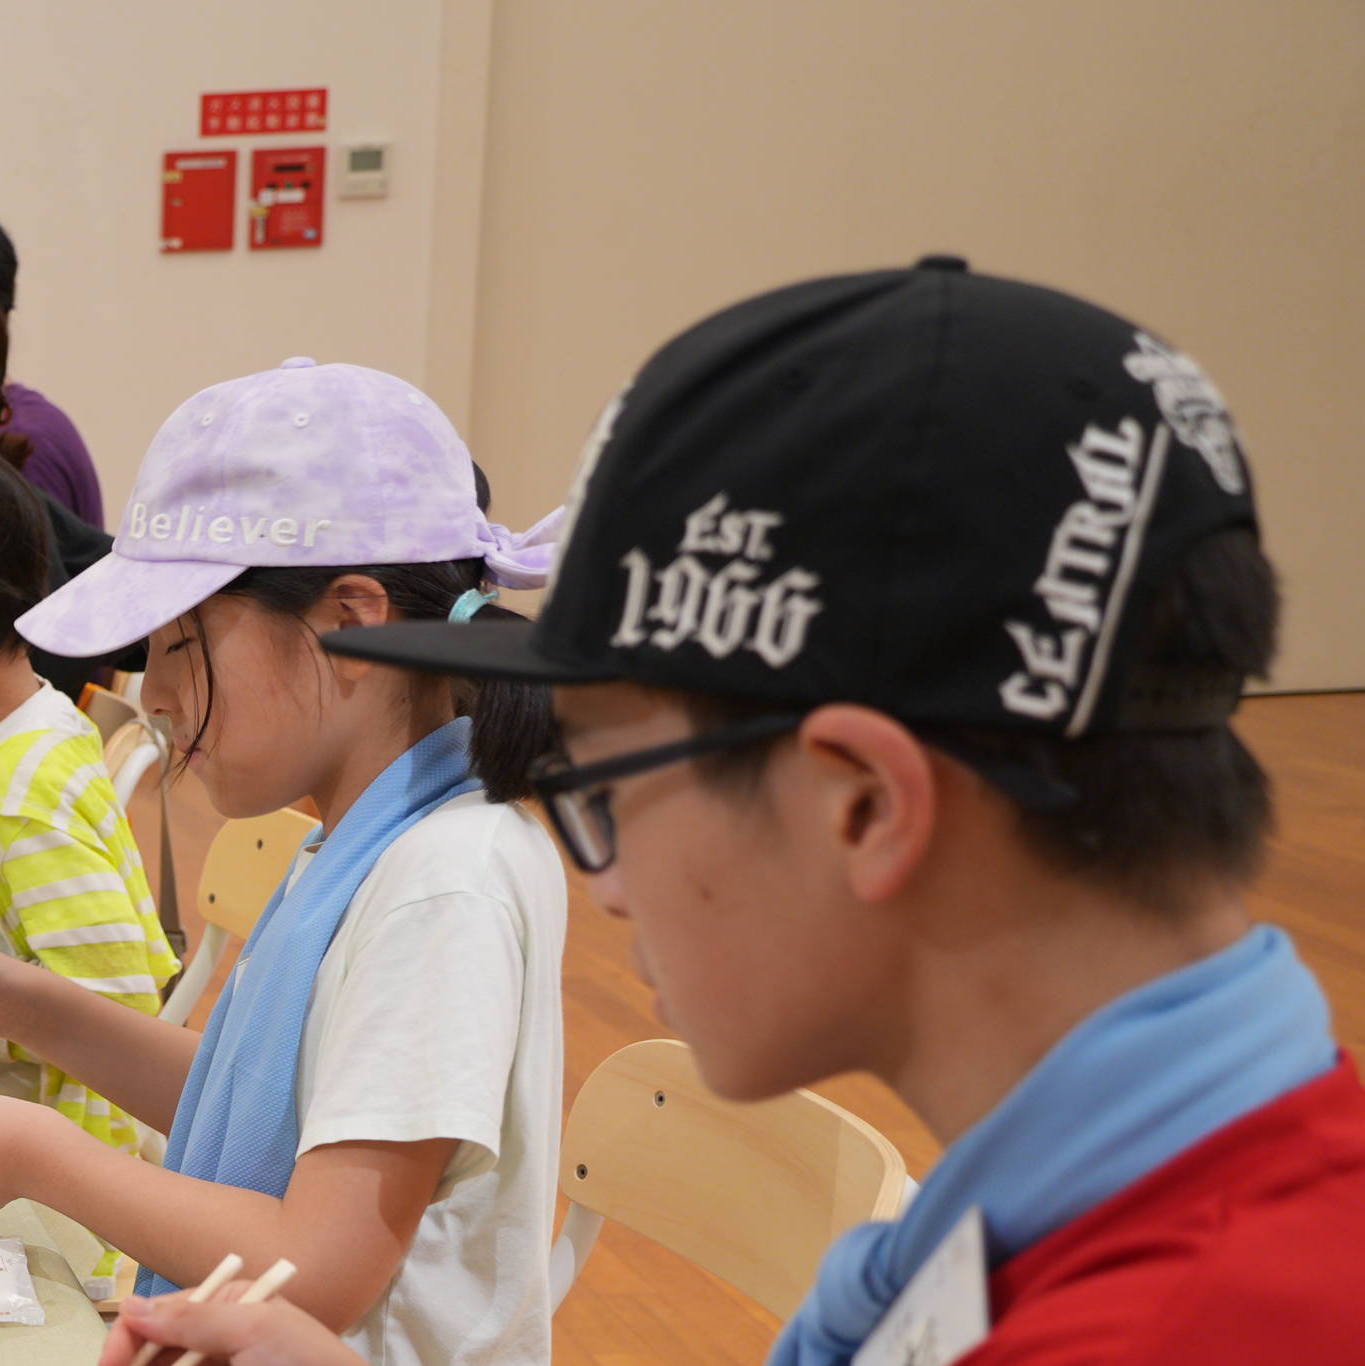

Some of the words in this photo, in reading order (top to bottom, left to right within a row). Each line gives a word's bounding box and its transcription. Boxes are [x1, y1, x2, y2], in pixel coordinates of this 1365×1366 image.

[129, 503, 332, 547] Believer
[997, 416, 1144, 721] CENTRAL
[610, 546, 824, 669] 1966
